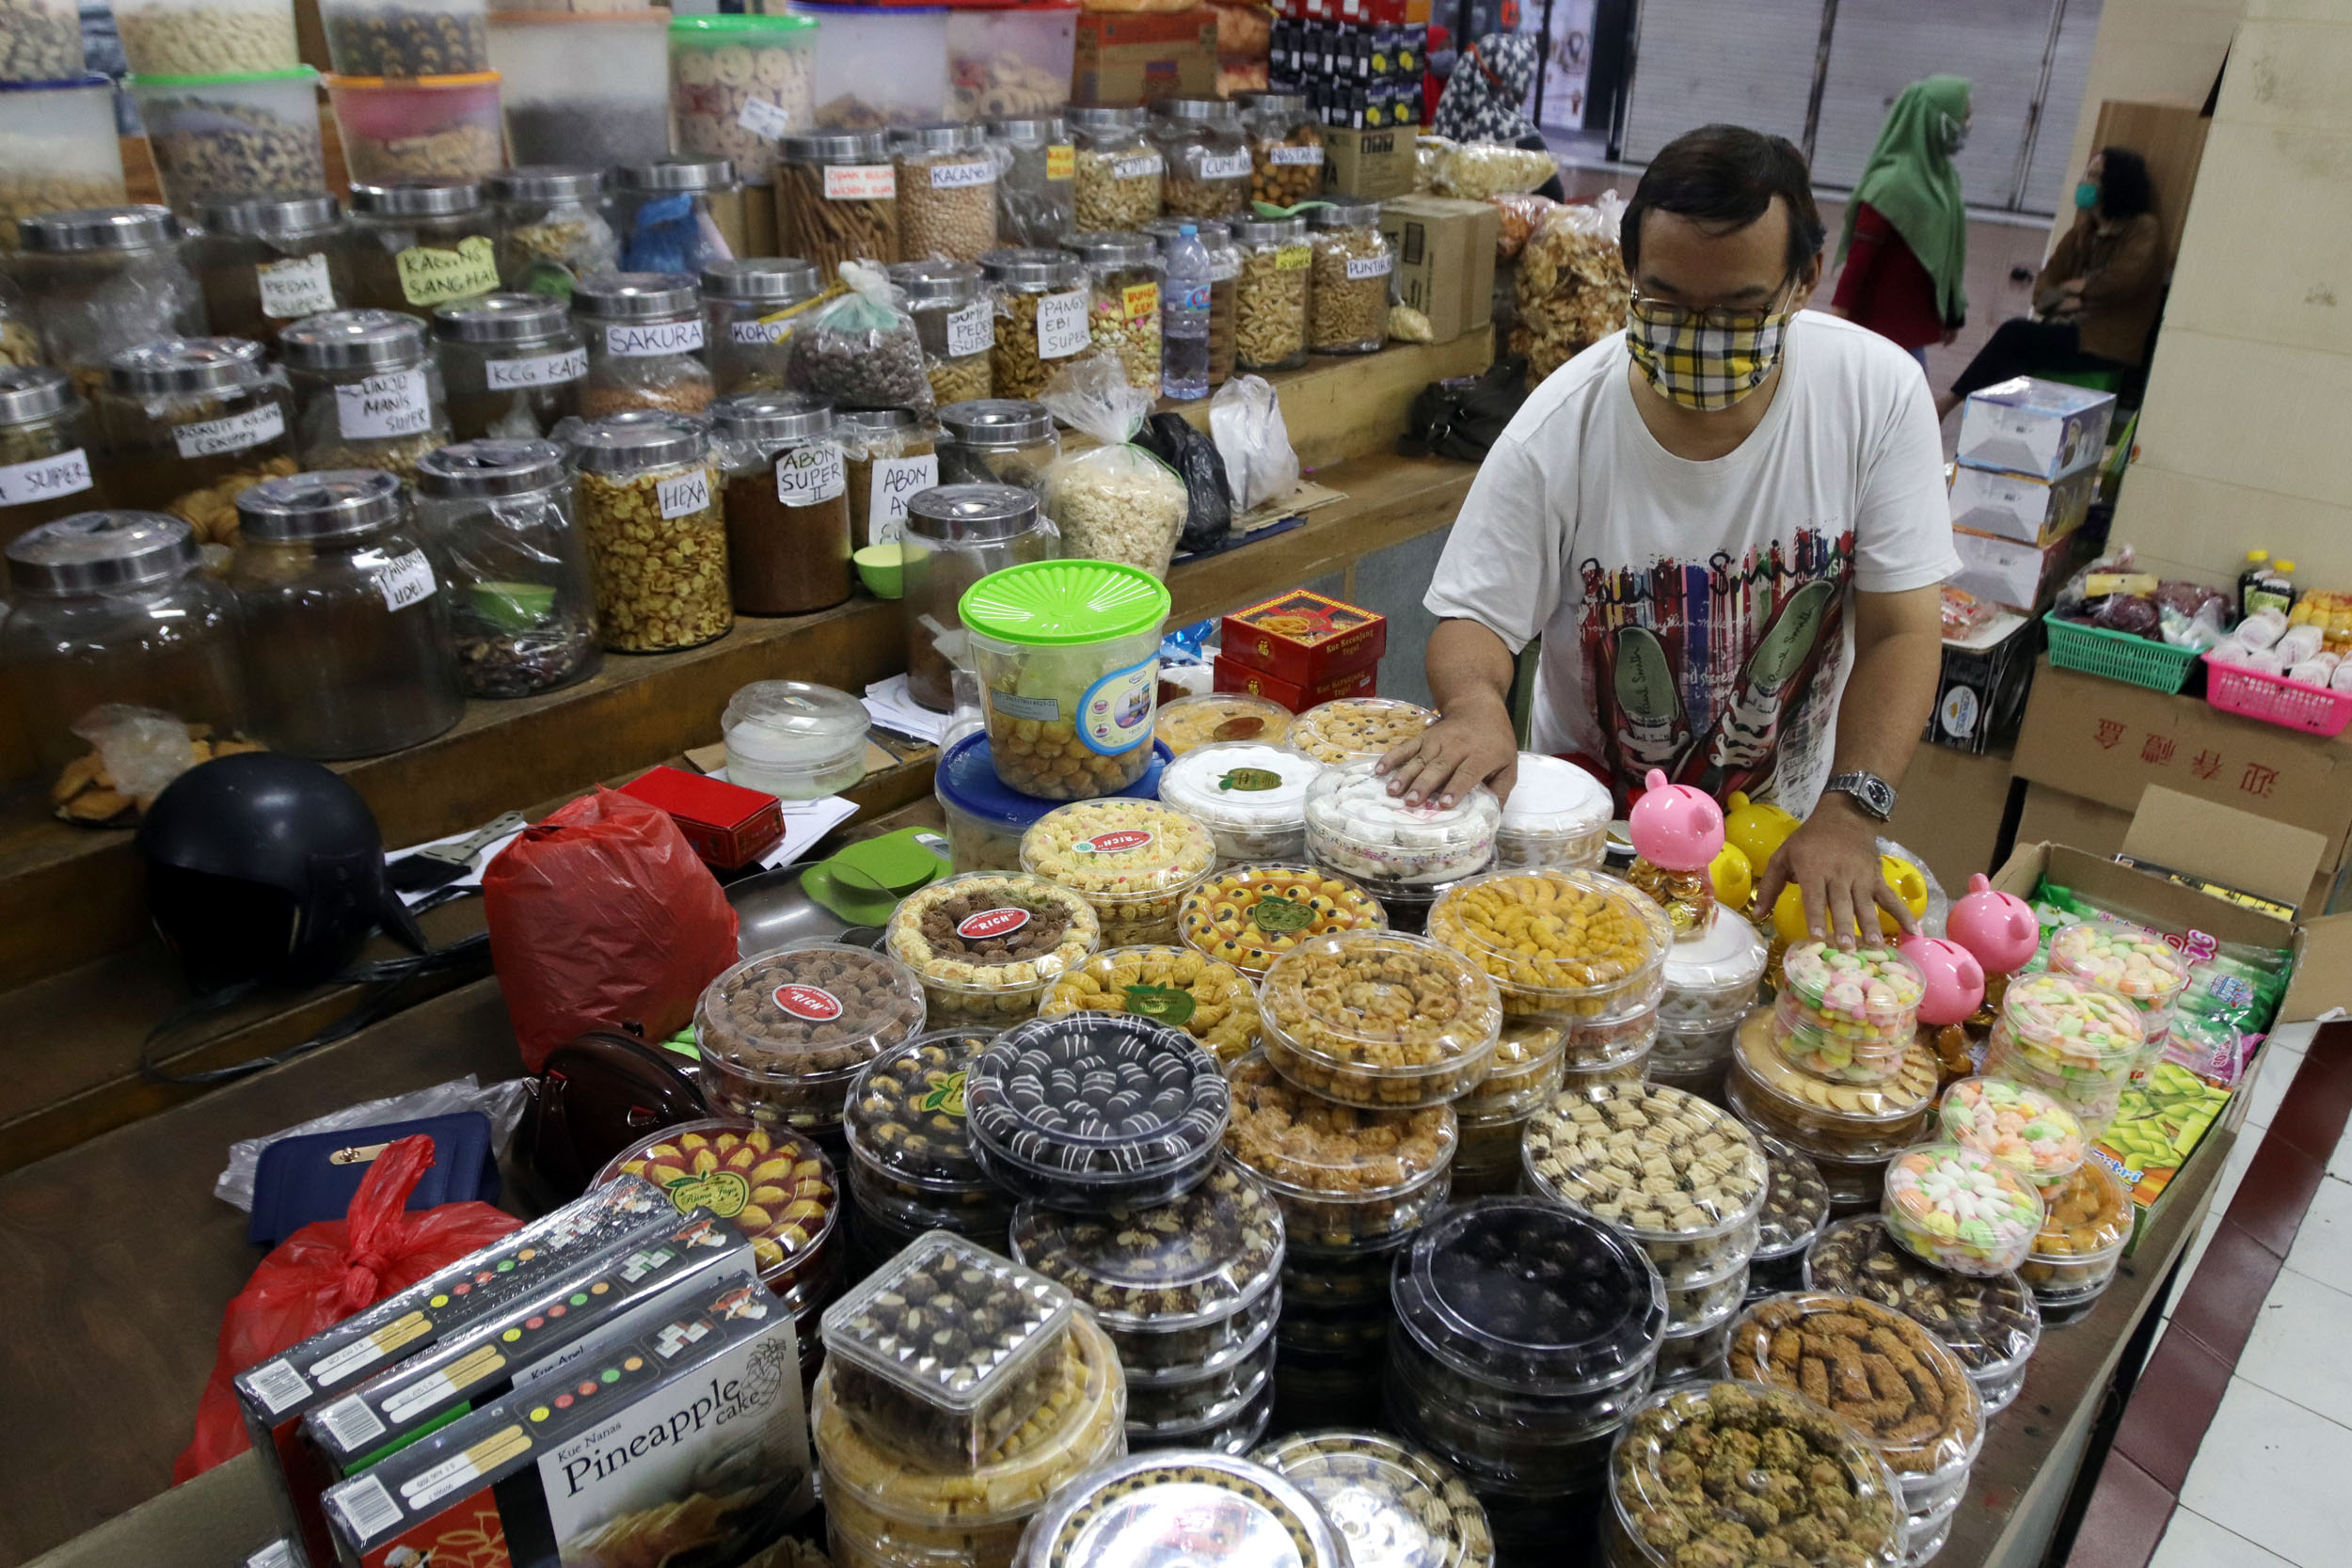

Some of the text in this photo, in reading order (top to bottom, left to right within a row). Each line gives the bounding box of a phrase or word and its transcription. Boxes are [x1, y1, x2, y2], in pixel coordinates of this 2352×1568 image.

[734, 325, 781, 341] KORO
[1046, 317, 1070, 332] EBI
[610, 325, 702, 353] SAKURA
[1048, 331, 1091, 352] SUPER
[493, 365, 536, 383] KCG
[783, 449, 836, 470] ABON
[782, 464, 841, 492] SUPER
[883, 466, 928, 493] ABON
[663, 480, 707, 511] HEXA
[1327, 629, 1375, 654] Kue Keranjang
[1343, 643, 1360, 657] Tegal
[1317, 684, 1331, 695] Kue
[2092, 718, 2281, 800] 迎春禮盒
[1098, 834, 1141, 848] "RICH"
[971, 912, 1014, 931] "RICH"
[790, 990, 832, 1012] "RICH"
[716, 1389, 761, 1427] cake
[557, 1421, 623, 1464] Kue Nanas
[562, 1378, 740, 1498] Pineapple
